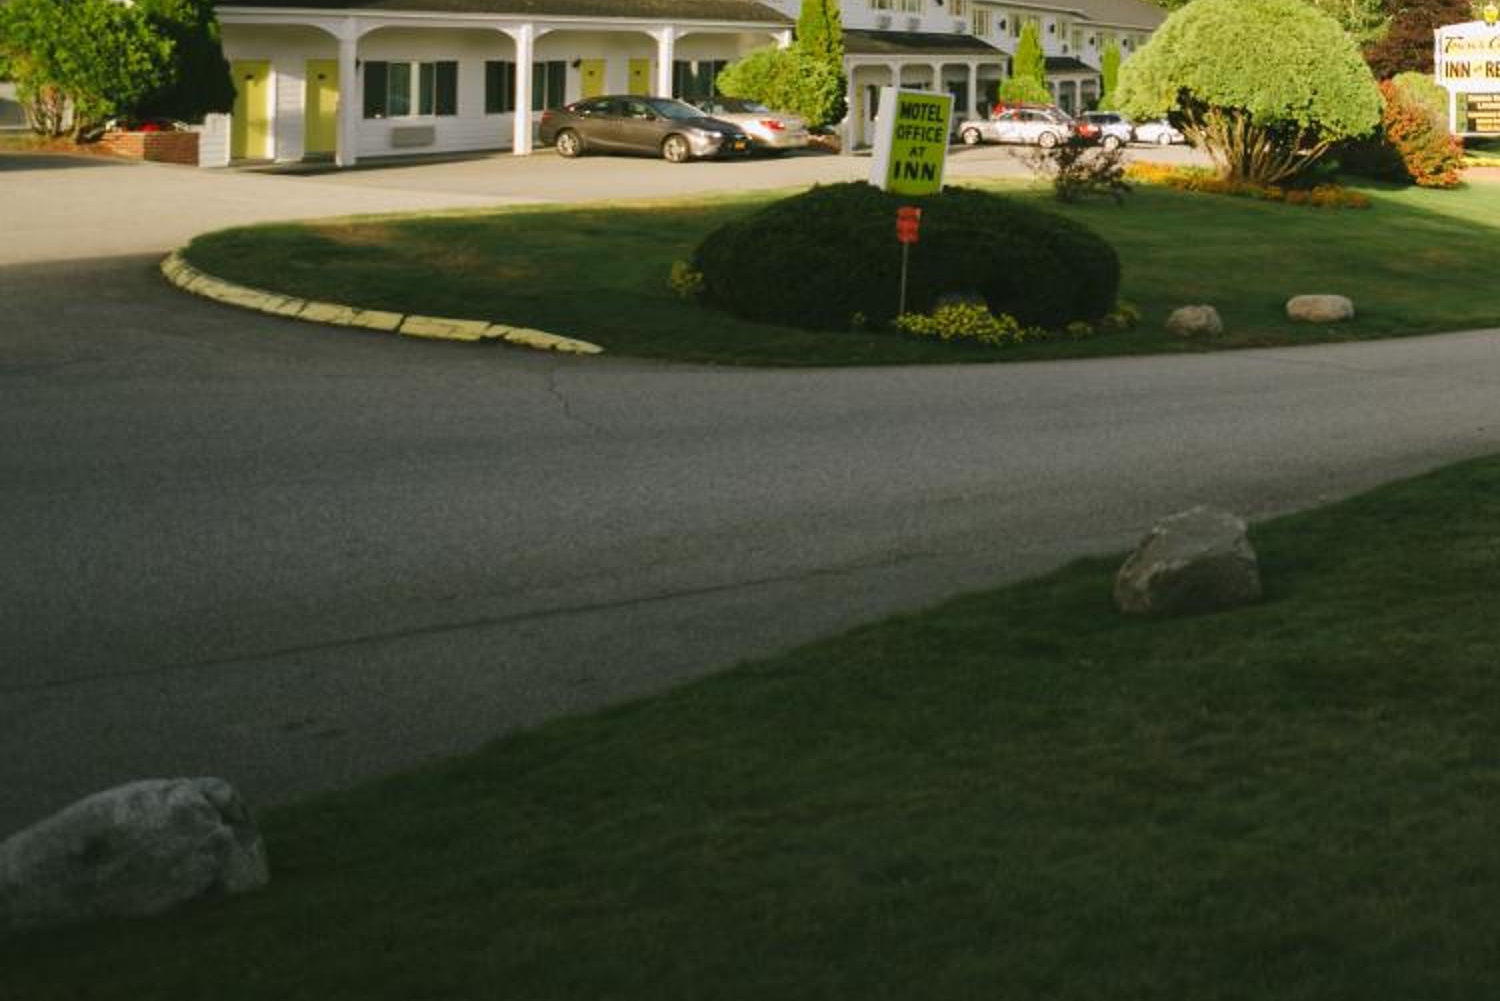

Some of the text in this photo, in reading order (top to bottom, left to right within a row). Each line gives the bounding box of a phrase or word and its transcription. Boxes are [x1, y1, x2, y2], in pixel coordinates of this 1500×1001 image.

[1445, 61, 1470, 77] INN
[900, 100, 944, 122] MOTEL
[896, 125, 944, 143] OFFICE
[909, 146, 926, 157] AT
[893, 160, 936, 181] INN
